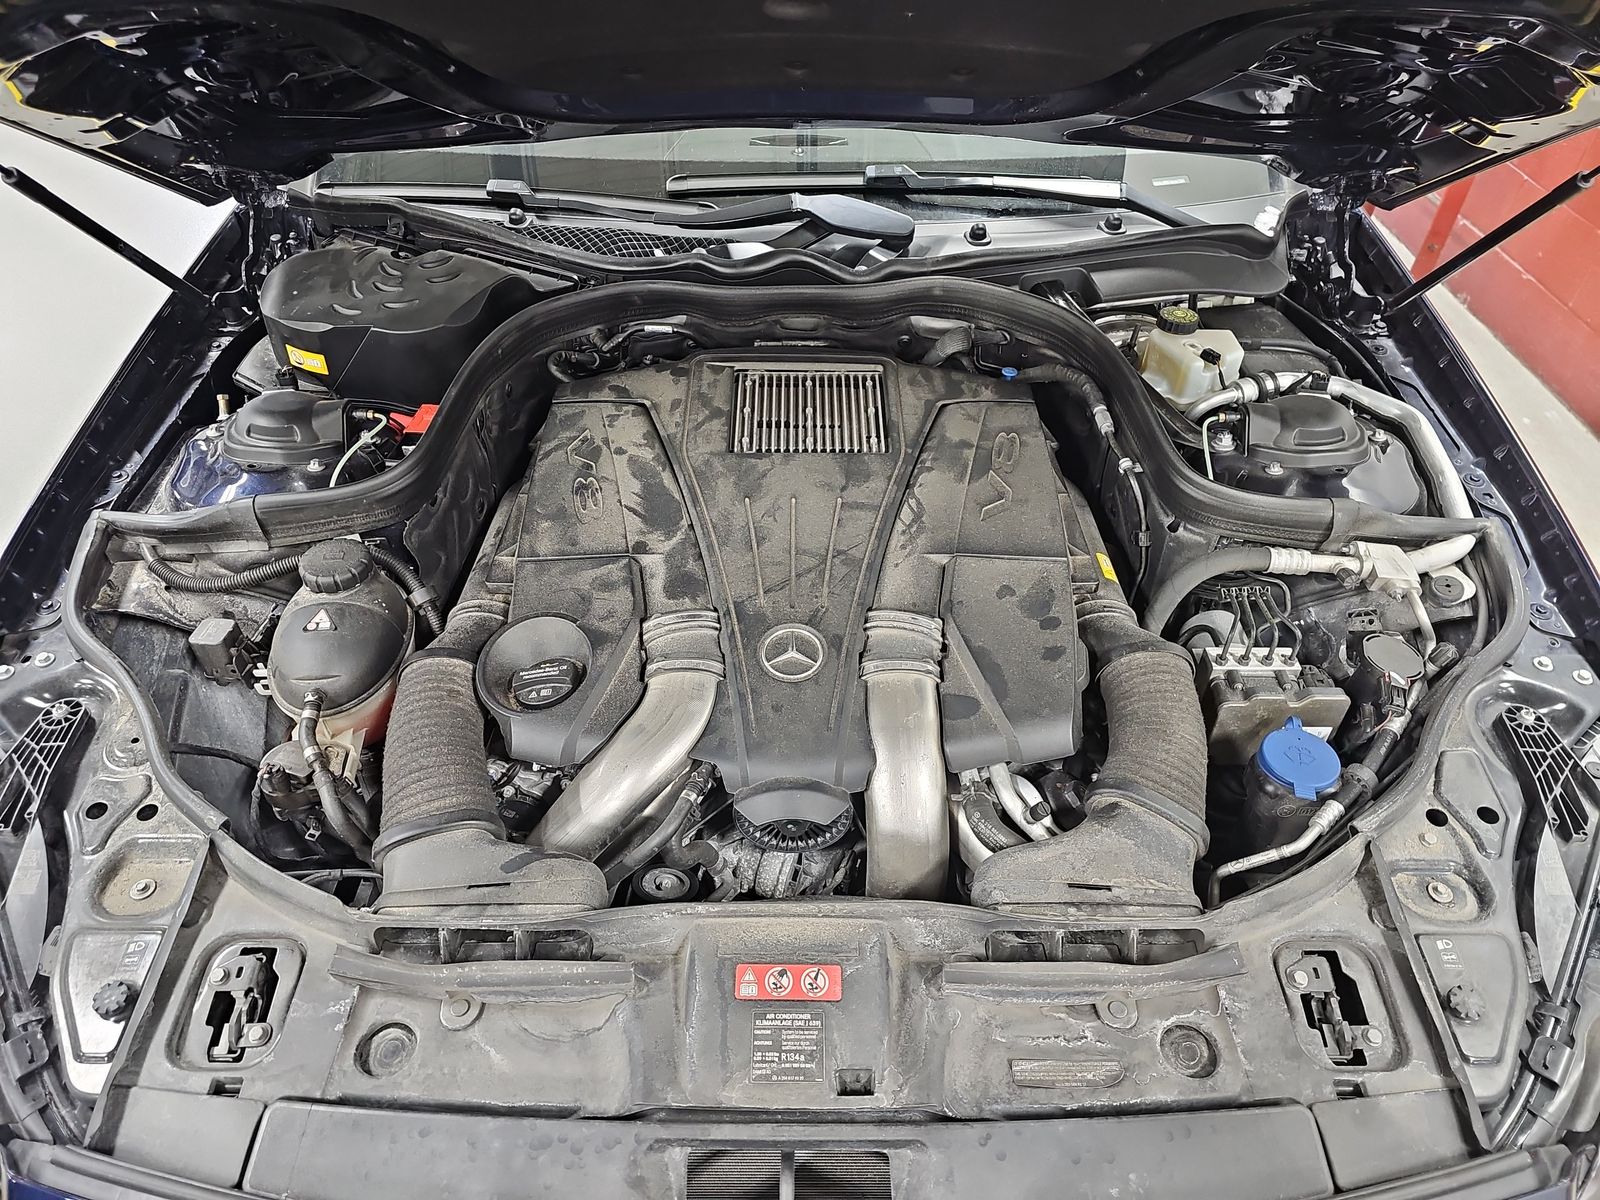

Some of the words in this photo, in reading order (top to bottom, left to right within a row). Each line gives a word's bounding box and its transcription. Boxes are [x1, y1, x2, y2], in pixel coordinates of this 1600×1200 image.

[567, 429, 603, 524] V8
[981, 432, 1020, 521] V8
[781, 1053, 805, 1061] R134a
